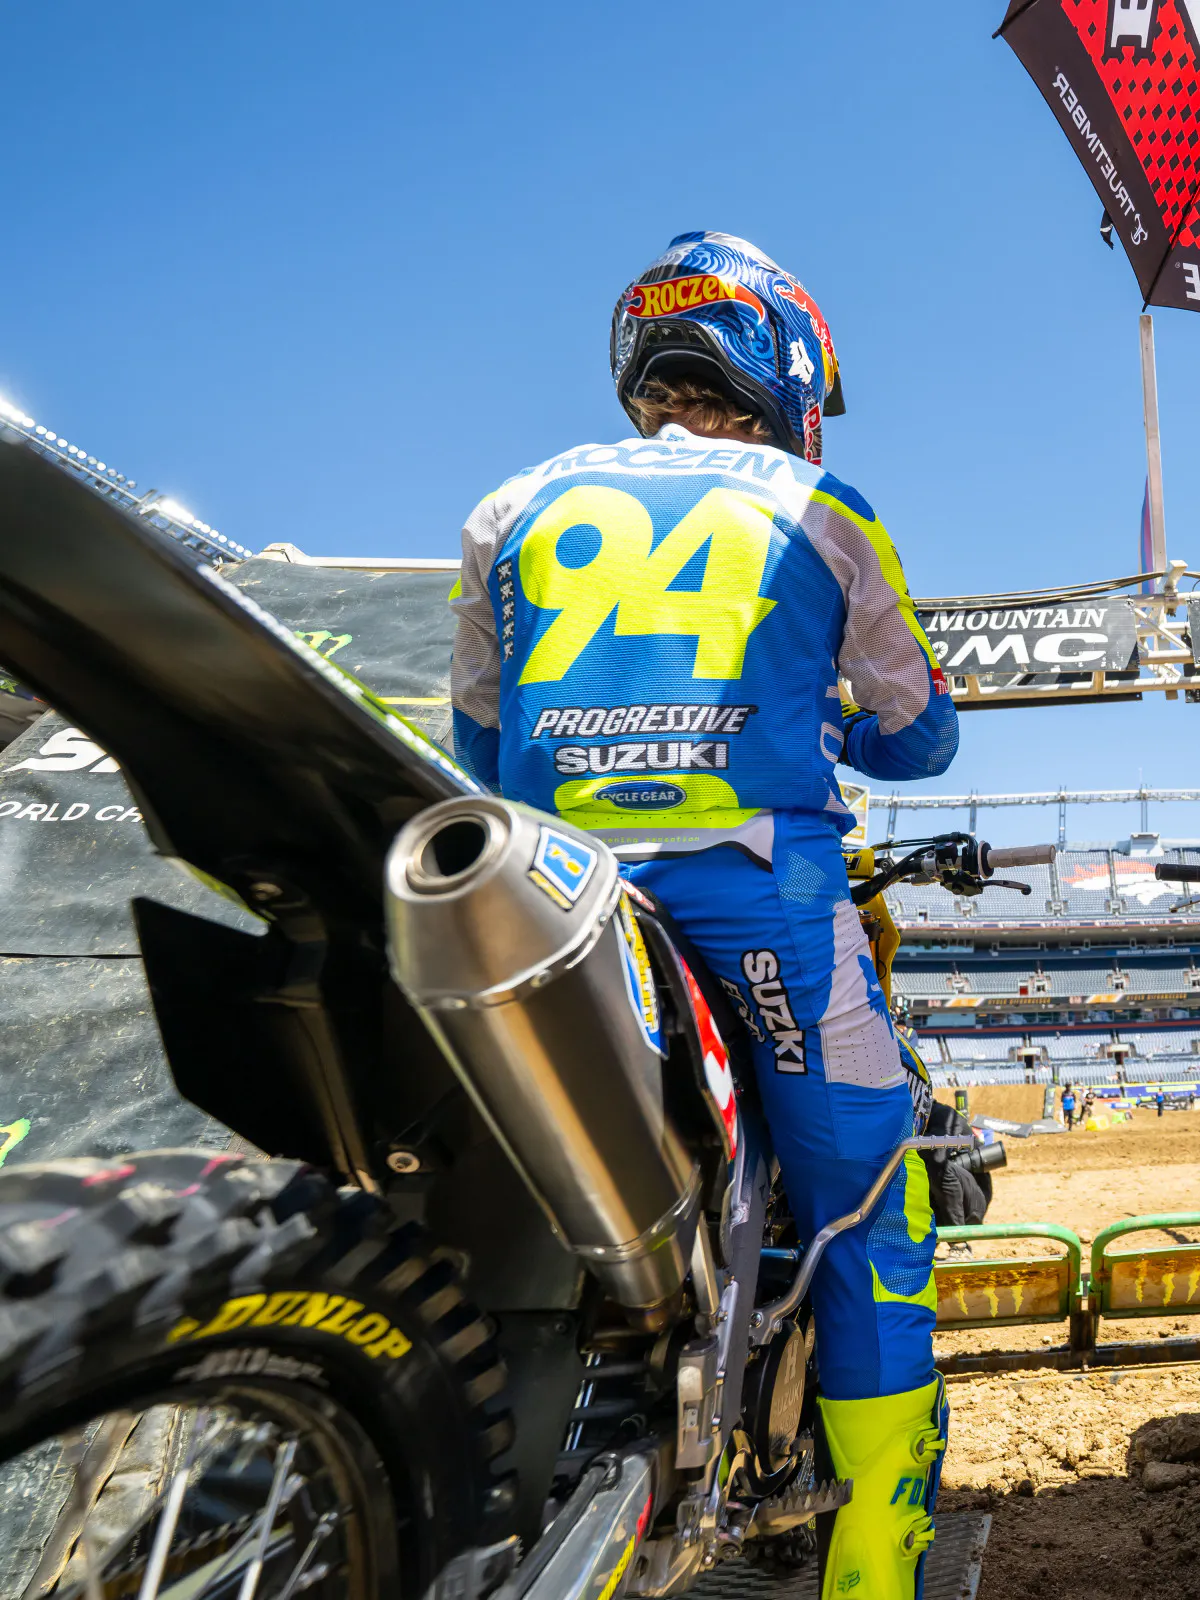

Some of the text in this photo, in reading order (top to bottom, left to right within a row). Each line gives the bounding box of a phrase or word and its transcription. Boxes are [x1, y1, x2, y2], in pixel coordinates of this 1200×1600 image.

[543, 444, 786, 482] ROCZEN
[517, 484, 778, 685] 94
[928, 607, 1108, 632] MOUNTAIN
[530, 705, 751, 738] PROGRESSIVE
[554, 741, 730, 775] SUZUKI
[601, 791, 676, 802] CYCLE GEAR
[742, 949, 806, 1074] SUZUKI
[192, 1291, 413, 1359] DUNLOP
